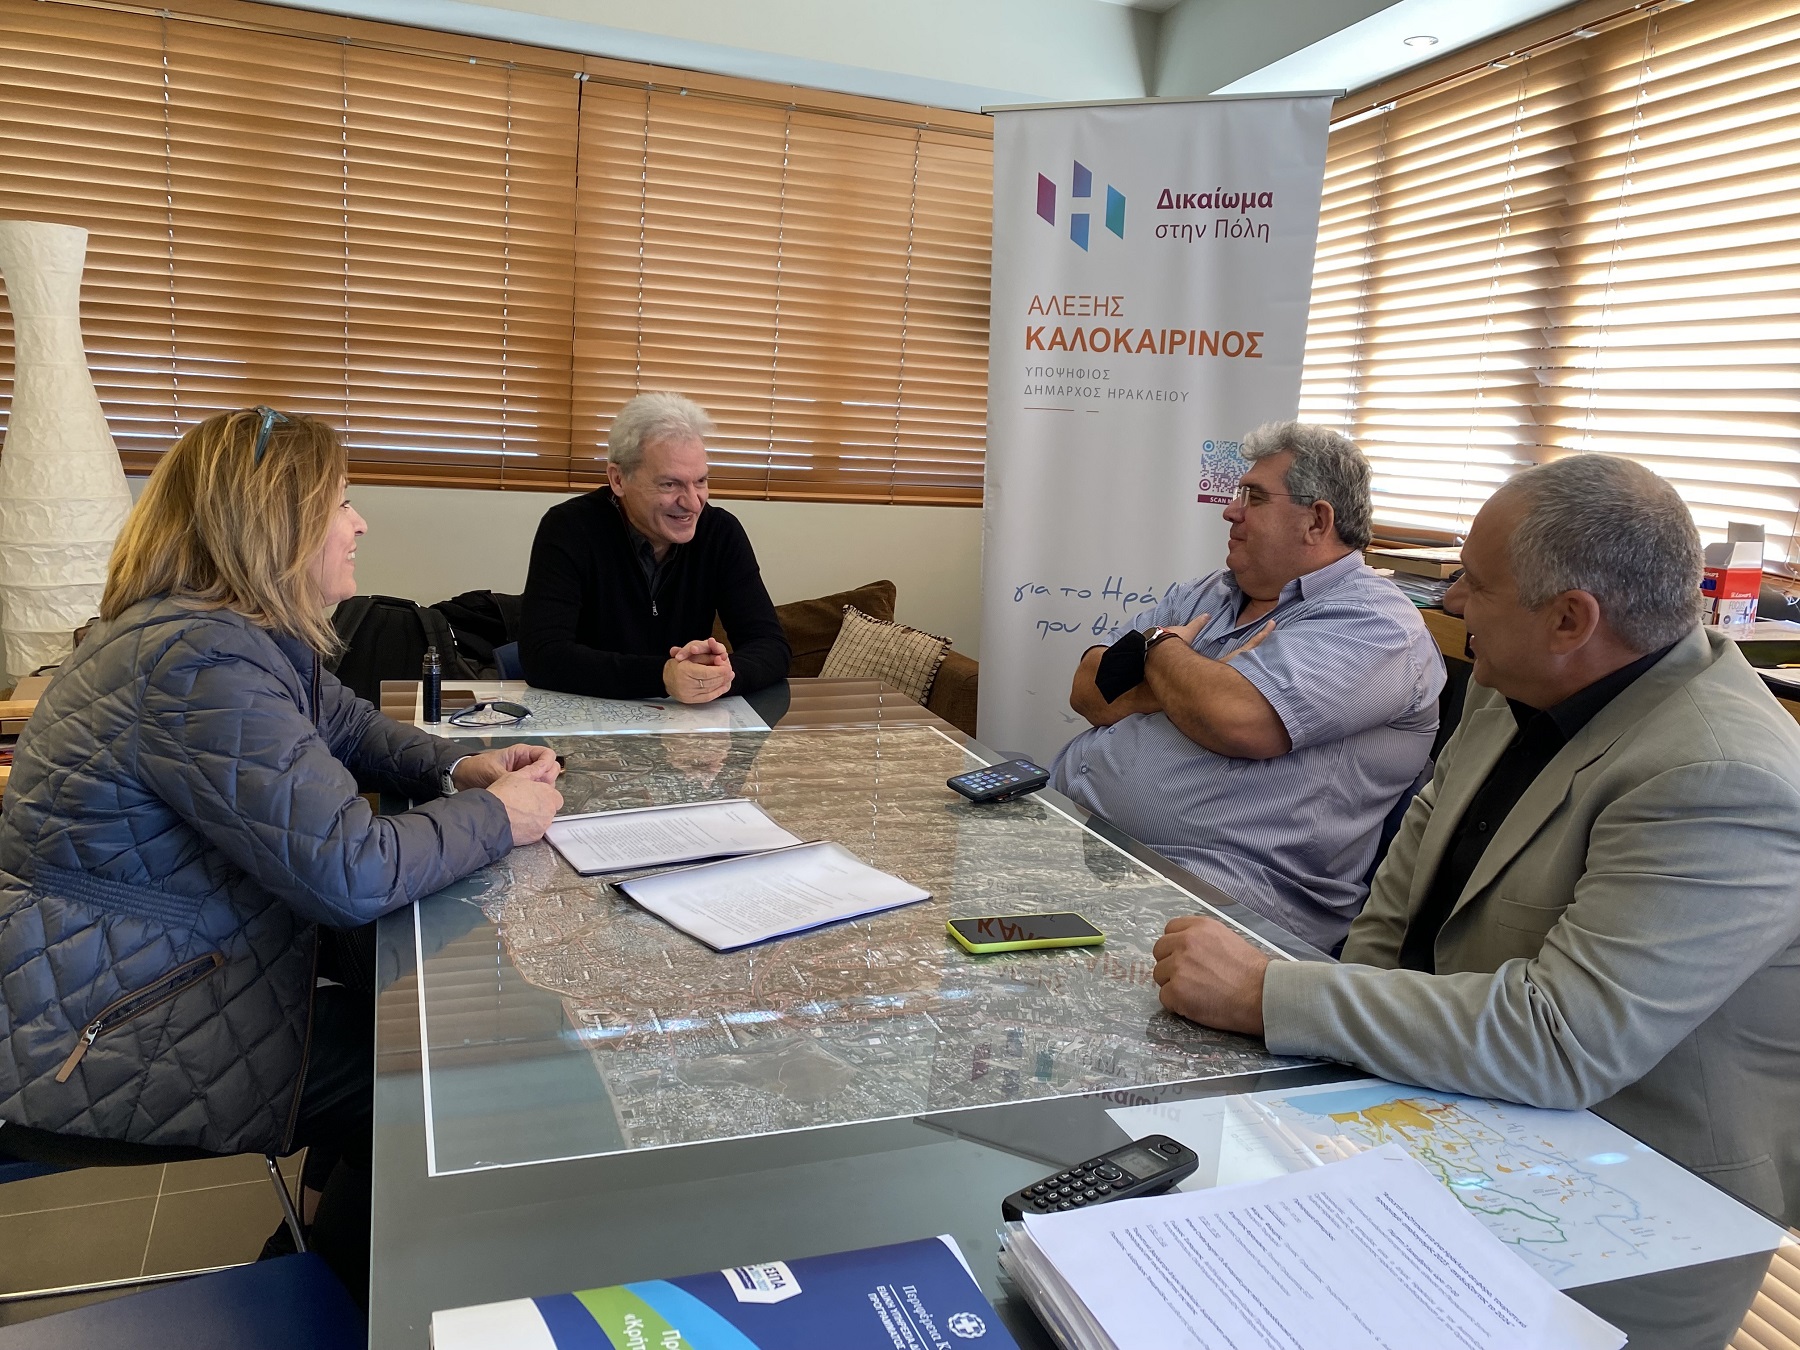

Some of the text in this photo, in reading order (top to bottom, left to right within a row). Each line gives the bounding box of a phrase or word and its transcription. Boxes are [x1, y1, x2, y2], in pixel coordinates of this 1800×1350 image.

[1156, 187, 1274, 214] Δικαίωμα
[1155, 218, 1270, 244] στην Πόλη
[1028, 295, 1125, 317] ΑΛΕΞΗΣ
[1025, 326, 1264, 358] ΚΑΛΟΚΑΙΡΙΝΟΣ
[1025, 366, 1110, 380] ΥΠΟΨΗΦΙΟΣ
[1024, 384, 1189, 402] ΔΗΜΑΡΧΟΣ ΗΡΑΚΛΕΙΟΥ
[1210, 496, 1227, 504] SCAN
[1014, 576, 1177, 613] για το Ηρά
[1036, 620, 1081, 641] που
[902, 1285, 942, 1341] Περιφέρεια
